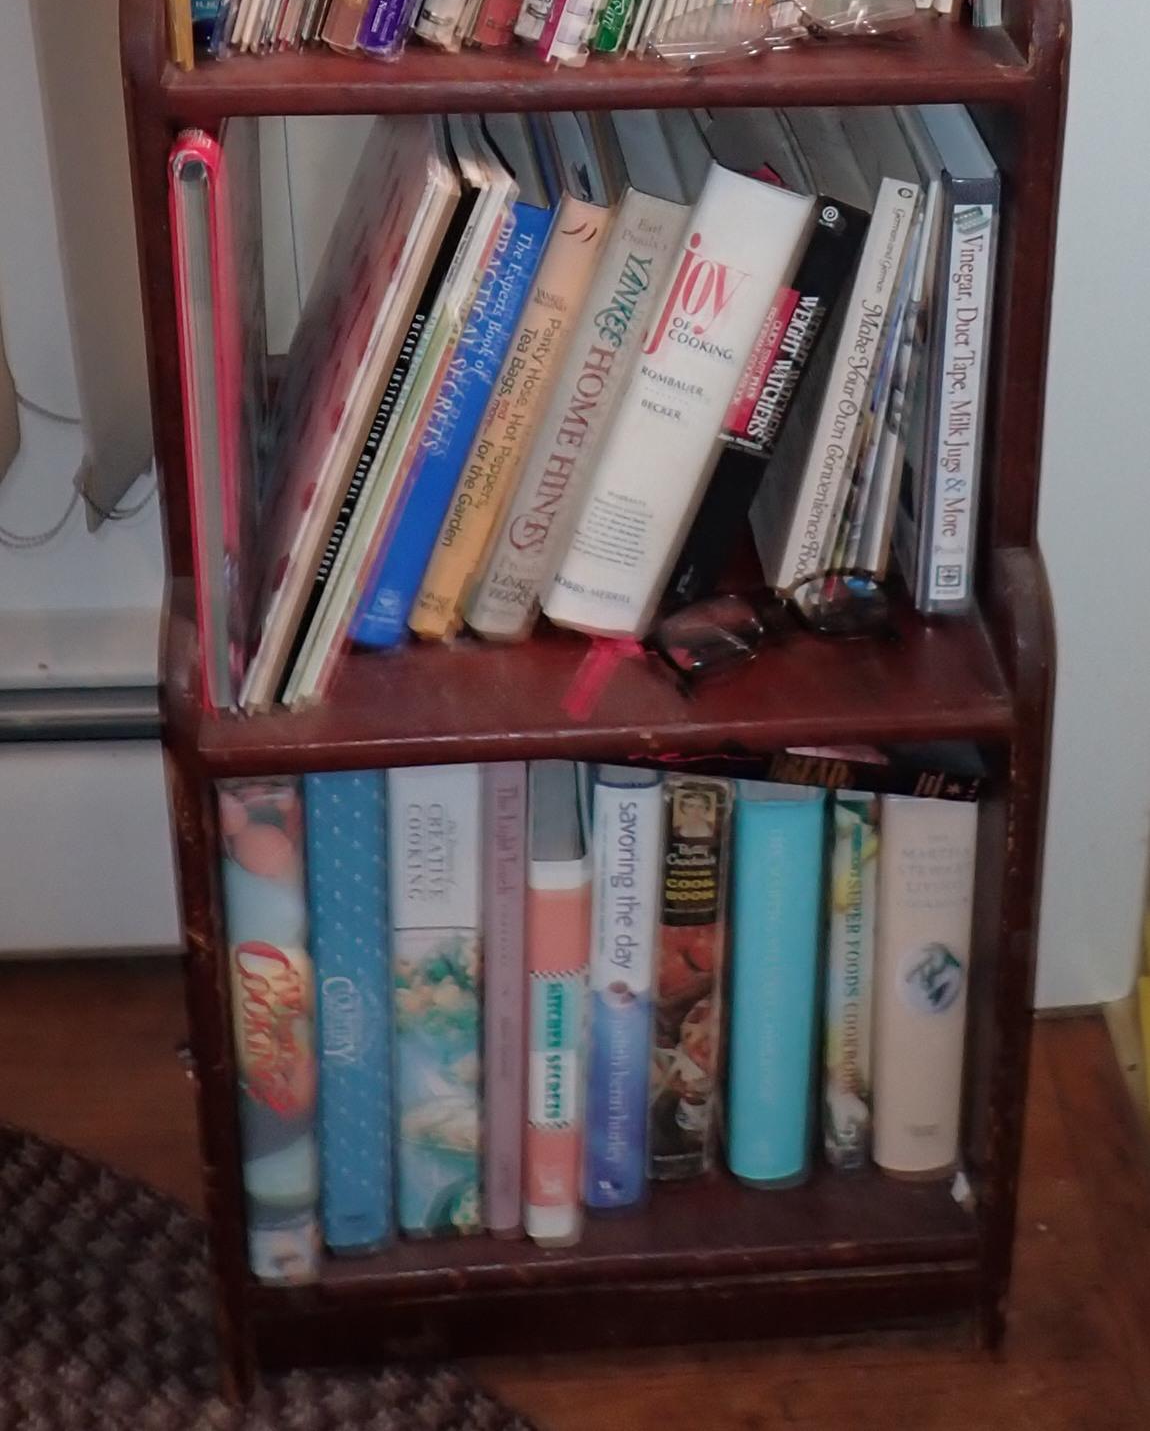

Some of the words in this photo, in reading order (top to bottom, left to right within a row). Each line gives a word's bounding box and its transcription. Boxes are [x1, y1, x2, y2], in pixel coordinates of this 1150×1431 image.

[513, 232, 535, 261] The
[952, 234, 984, 302] Vinegar,
[492, 261, 523, 318] Experts
[593, 252, 653, 349] YANKEE
[641, 231, 751, 356] joy
[478, 319, 503, 356] Book
[515, 328, 540, 354] Tea
[531, 317, 562, 365] Panty
[667, 328, 733, 361] COOKING
[672, 317, 692, 331] OF
[779, 295, 820, 359] WEIGHT
[854, 299, 884, 354] Make
[953, 306, 979, 346] Duct
[473, 359, 486, 379] of
[498, 357, 527, 398] Bags,
[514, 366, 542, 411] Hose,
[640, 365, 705, 396] ROMBAUER
[842, 354, 872, 400] Your
[947, 350, 976, 395] Tape,
[364, 365, 406, 450] INSTRUCTION
[422, 357, 468, 455] SECRETS
[556, 345, 616, 448] HOME
[640, 398, 683, 421] BECKER
[746, 359, 794, 440] WATCHERS
[947, 399, 973, 437] Milk
[505, 412, 527, 443] Hot
[832, 399, 859, 440] Own
[477, 438, 494, 461] for
[939, 439, 970, 474] Jugs
[344, 452, 372, 502] MANUAL
[463, 461, 485, 491] the
[474, 444, 513, 509] Peppers,
[805, 443, 845, 547] Convenience
[944, 477, 966, 494] &
[441, 492, 473, 548] Garden
[508, 454, 577, 553] HINTS
[941, 498, 966, 538] More
[406, 803, 423, 900] COOKING
[609, 800, 638, 889] savoring
[665, 877, 716, 889] COOK
[615, 894, 641, 927] the
[847, 877, 863, 935] SUPER
[610, 934, 642, 970] day
[844, 940, 861, 999] FOODS
